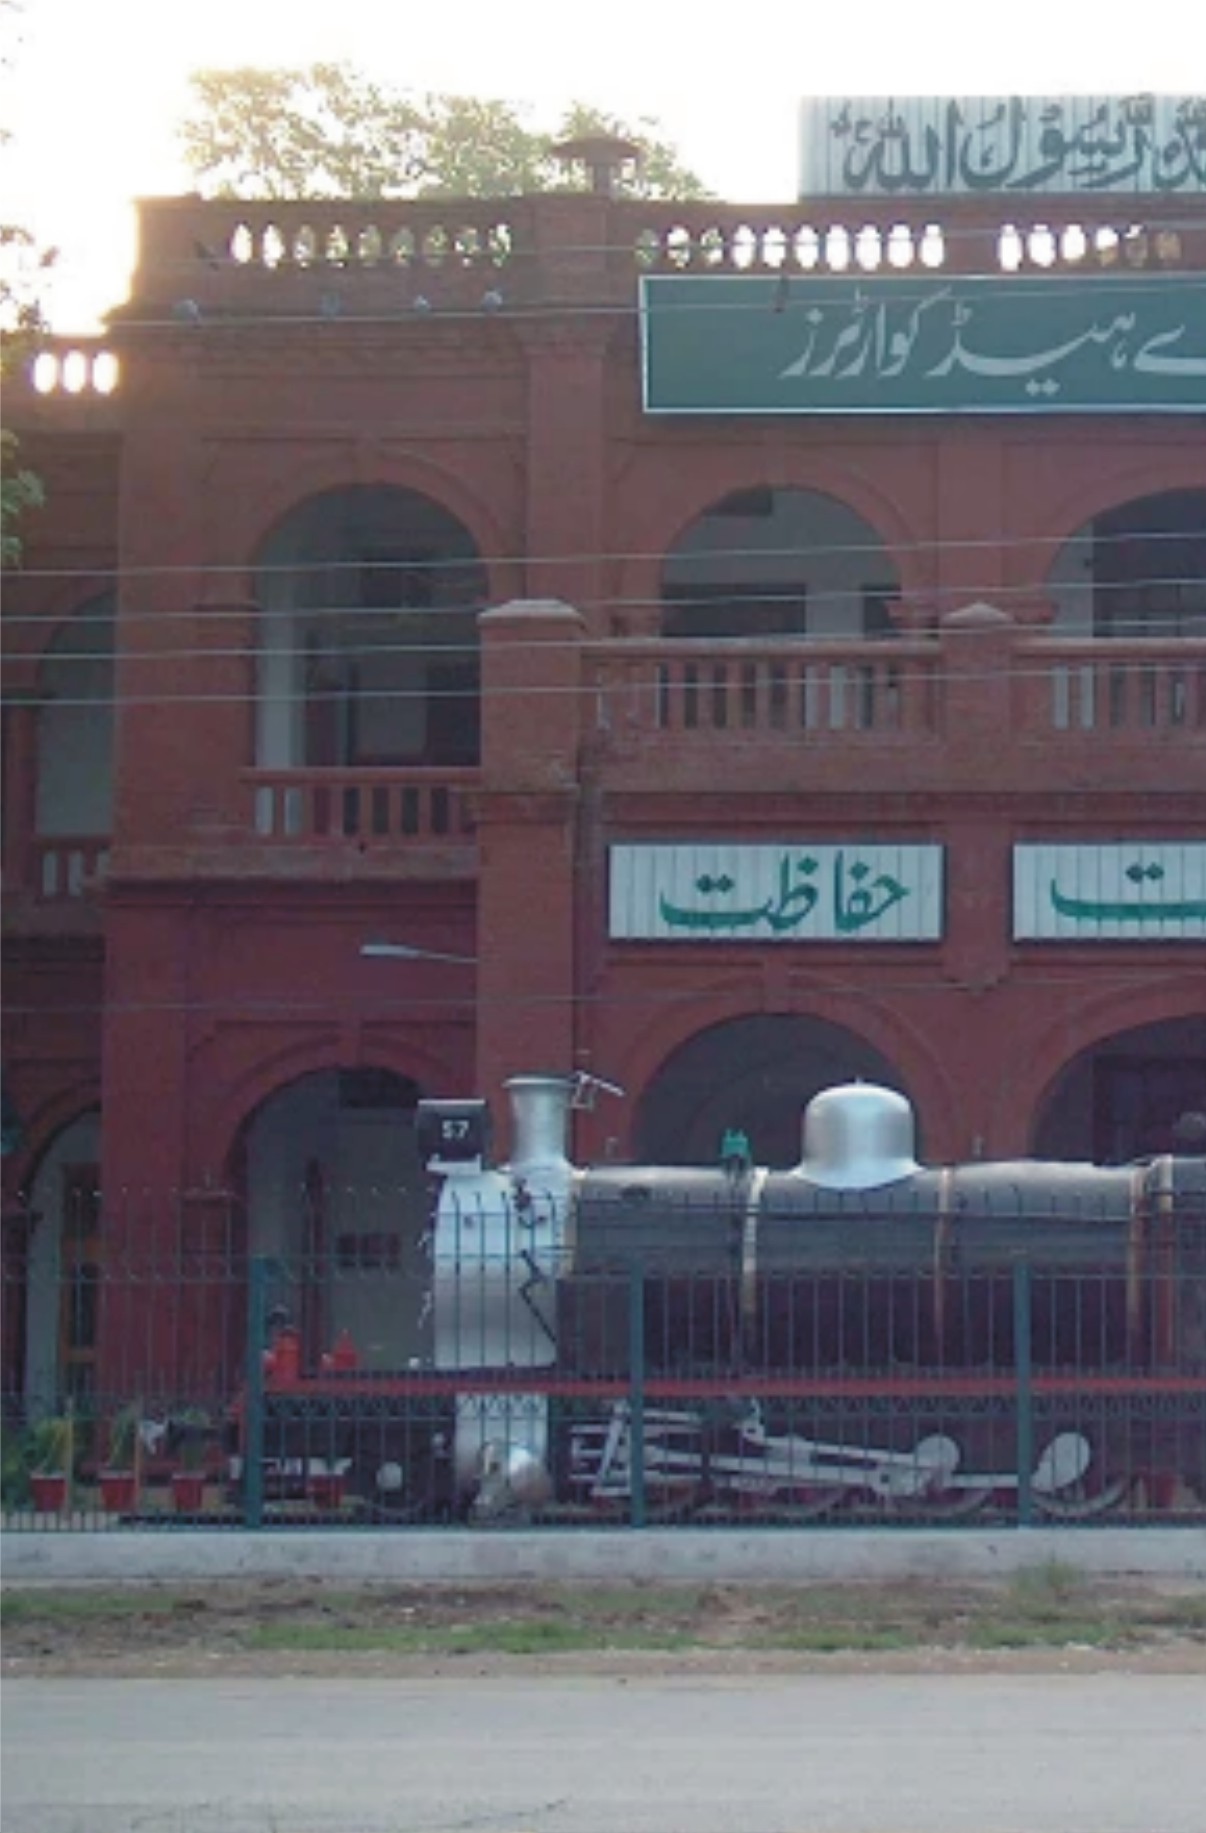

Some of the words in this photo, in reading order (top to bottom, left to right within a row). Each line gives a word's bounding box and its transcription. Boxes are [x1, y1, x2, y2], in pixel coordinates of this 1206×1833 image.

[926, 302, 1137, 396] ہیڈ
[659, 850, 911, 931] حفاظت
[442, 1119, 469, 1139] 57
